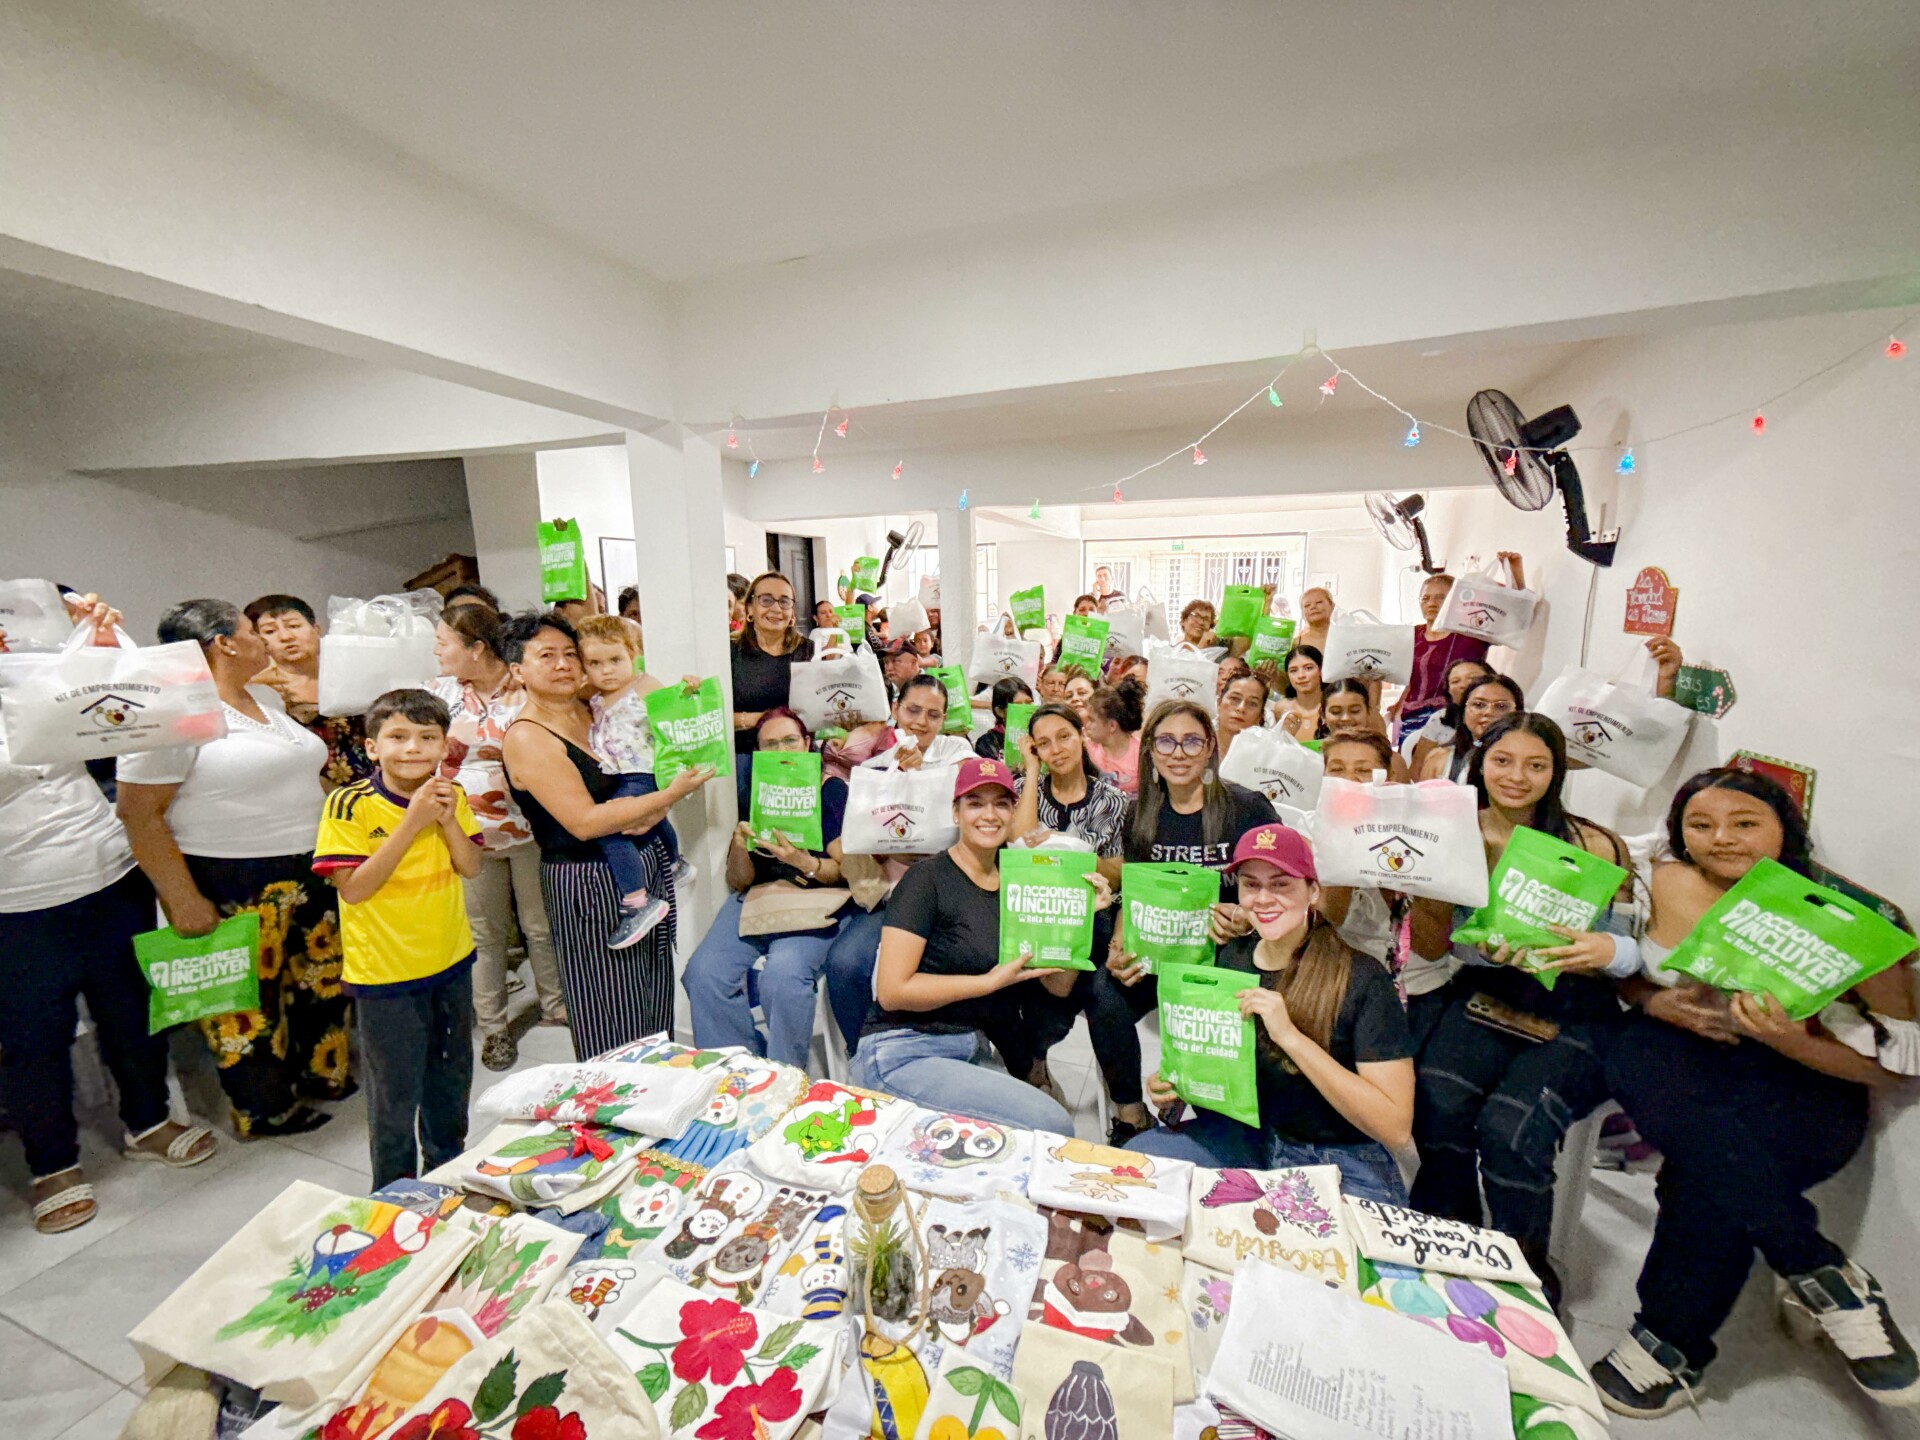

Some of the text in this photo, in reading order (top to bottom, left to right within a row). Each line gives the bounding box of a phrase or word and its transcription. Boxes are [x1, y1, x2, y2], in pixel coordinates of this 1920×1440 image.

[54, 683, 161, 704] KIT DE EMPRENDIMIENTO
[1585, 708, 1633, 737] EMPRENDIMIENTO
[1353, 824, 1439, 843] KIT DE EMPRENDIMIENTO
[1150, 842, 1230, 862] STREET
[1023, 885, 1080, 899] ACCIONES
[1022, 897, 1086, 916] INCLUYEN
[1145, 904, 1203, 921] ACCIONES
[1027, 915, 1084, 926] Ruta del cuidado
[1755, 911, 1849, 970] ACCIONES
[172, 947, 240, 970] ACCIONES
[1735, 921, 1849, 989] INCLUYEN
[171, 956, 251, 987] INCLUYEN
[1172, 1004, 1233, 1025] ACCIONES
[1172, 1018, 1242, 1047] INCLUYEN
[1191, 1043, 1203, 1053] del
[1206, 1046, 1239, 1059] cuidado
[1409, 1226, 1465, 1242] CON UN
[1382, 1228, 1512, 1271] Creada
